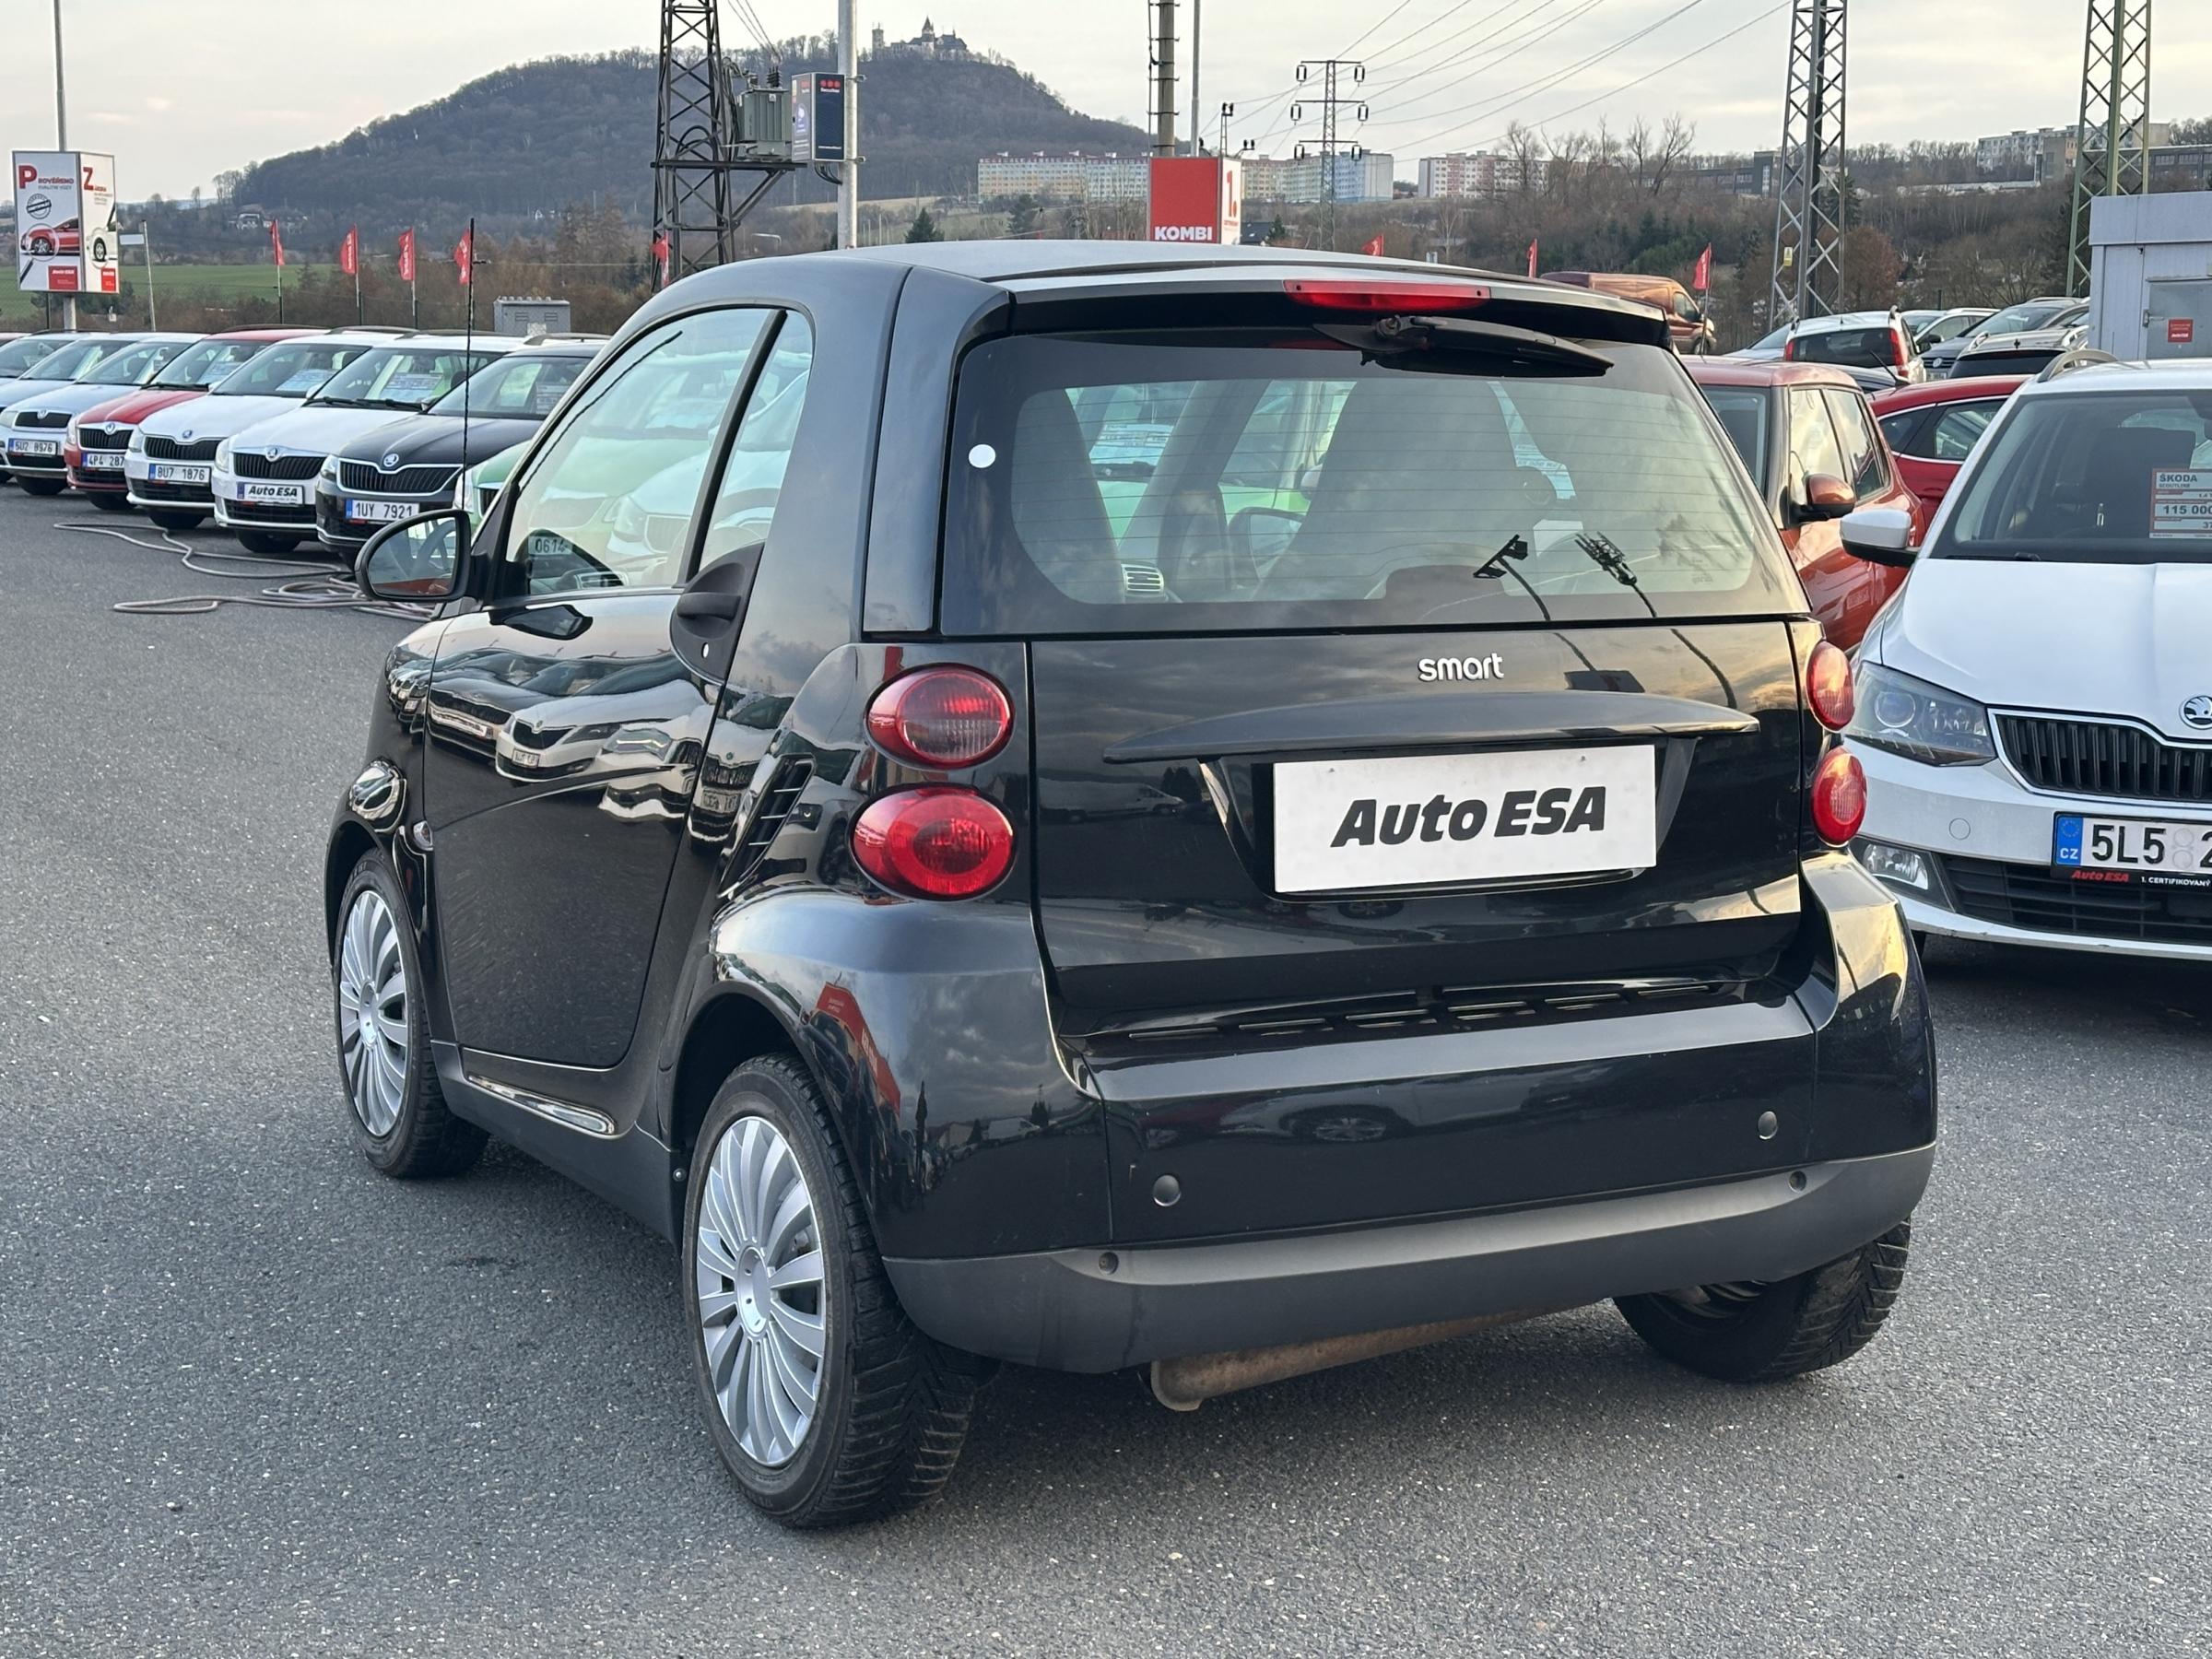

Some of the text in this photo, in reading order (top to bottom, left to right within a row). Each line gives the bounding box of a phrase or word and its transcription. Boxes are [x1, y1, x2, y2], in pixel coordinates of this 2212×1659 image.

[1154, 226, 1213, 241] KOMBI
[110, 456, 125, 466] 287
[157, 467, 205, 480] 8U7 1876
[2159, 474, 2197, 482] ŠKODA
[249, 486, 298, 497] Auto ESA
[356, 502, 412, 519] 1UY 7921
[2163, 505, 2187, 514] 115
[1418, 653, 1505, 682] smart
[1330, 786, 1606, 848] Auto ESA
[2092, 824, 2166, 865] 5L5
[2060, 848, 2078, 859] CZ
[2072, 870, 2129, 882] Auto ESA
[2148, 877, 2211, 888] CERTIFIKOVANÝ
